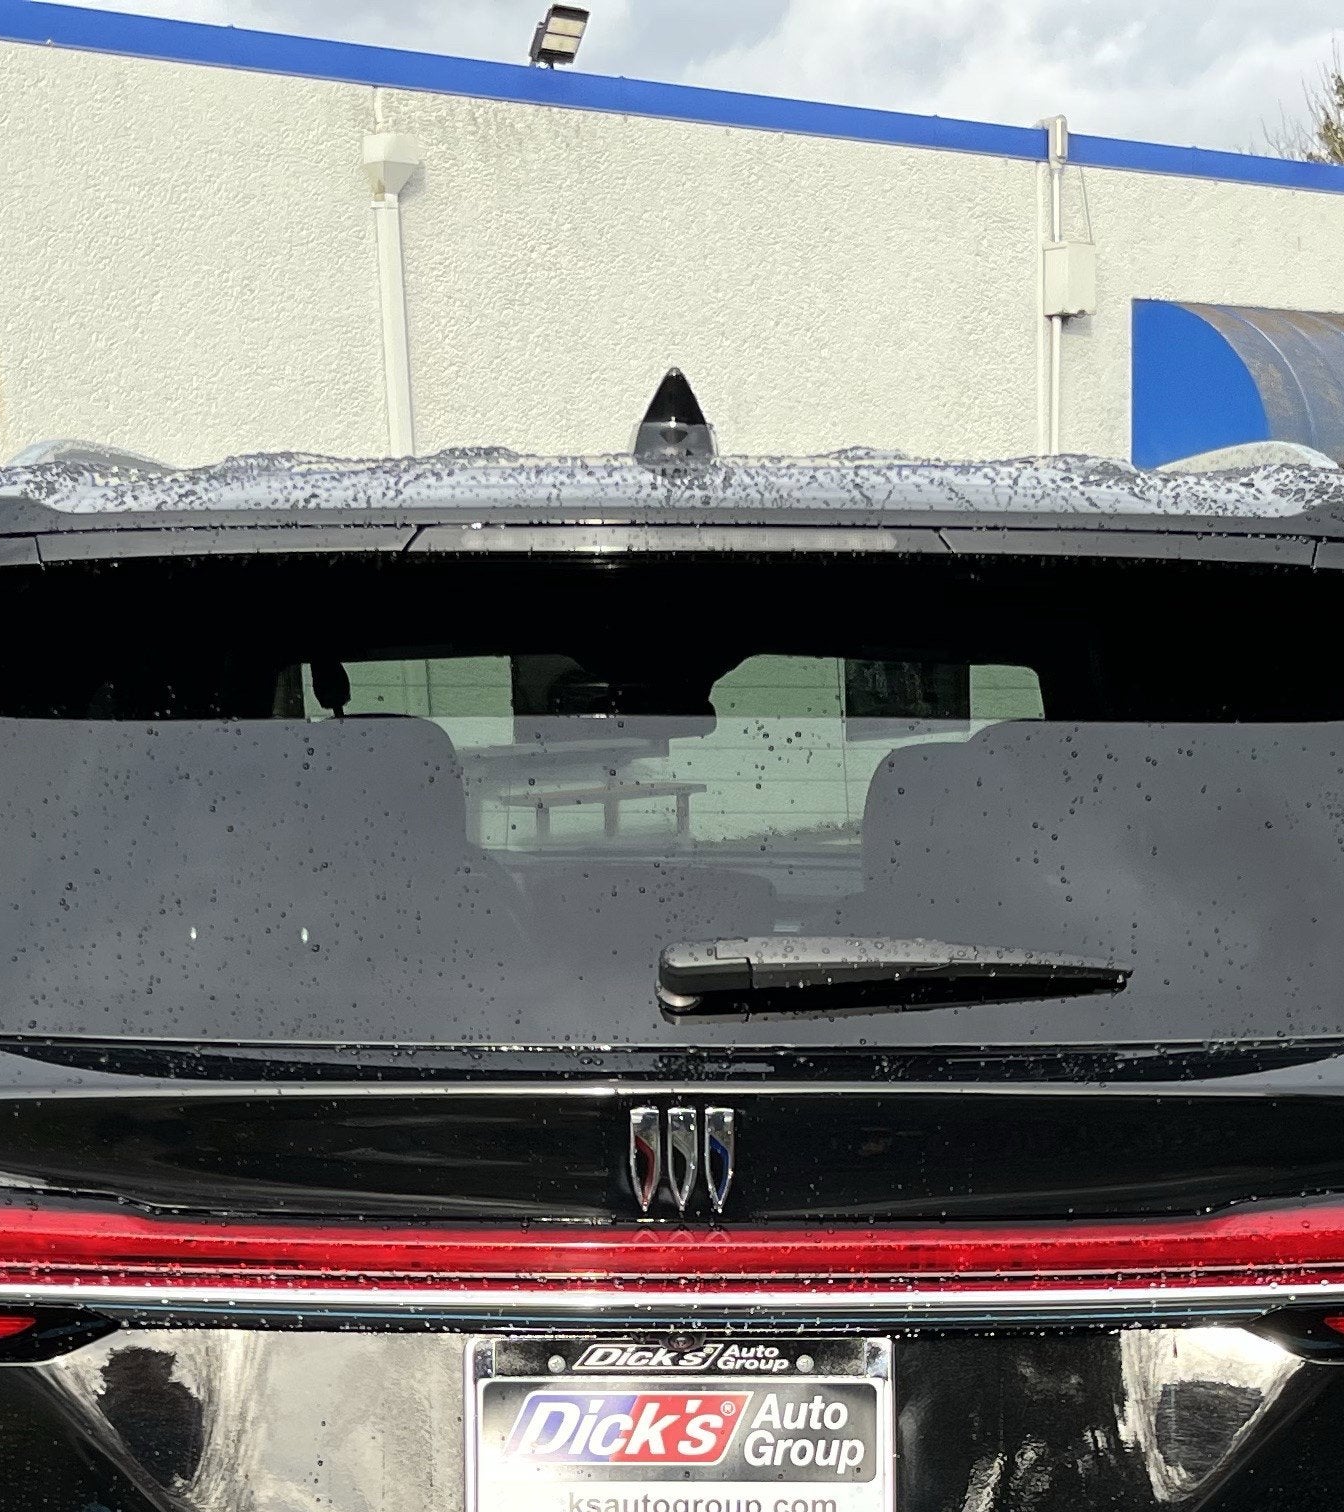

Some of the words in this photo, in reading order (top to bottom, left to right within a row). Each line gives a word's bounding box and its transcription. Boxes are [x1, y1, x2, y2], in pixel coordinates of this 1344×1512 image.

[583, 1345, 707, 1367] Dicks
[722, 1344, 780, 1358] Auto
[717, 1356, 789, 1372] Group
[750, 1393, 849, 1431] Auto
[744, 1430, 866, 1474] Group
